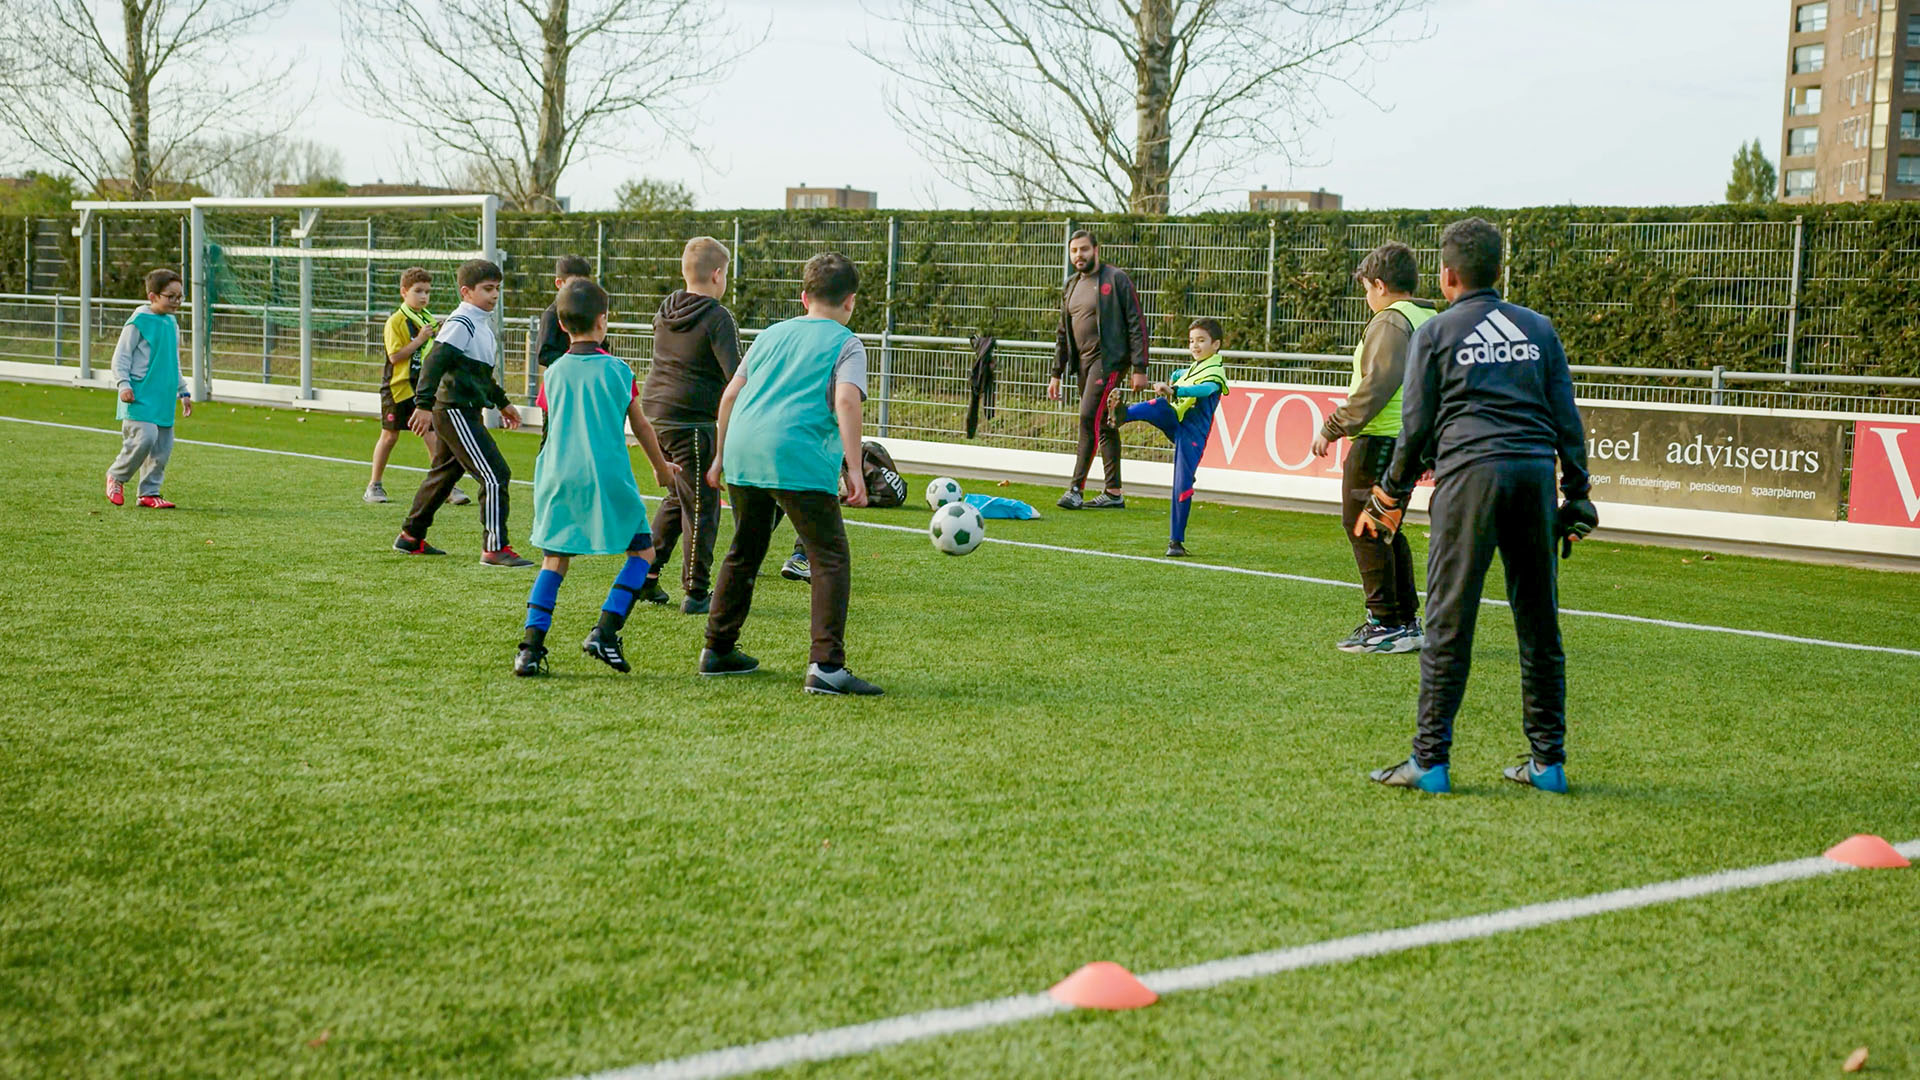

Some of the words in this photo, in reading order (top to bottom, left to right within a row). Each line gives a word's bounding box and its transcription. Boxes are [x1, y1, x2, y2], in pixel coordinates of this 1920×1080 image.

[1456, 341, 1540, 365] adidas
[1586, 428, 1641, 462] ieel
[1666, 434, 1820, 474] adviseurs
[1619, 474, 1681, 491] financieringen
[1689, 481, 1743, 495] pensioenen
[1751, 486, 1817, 500] spaarplannen
